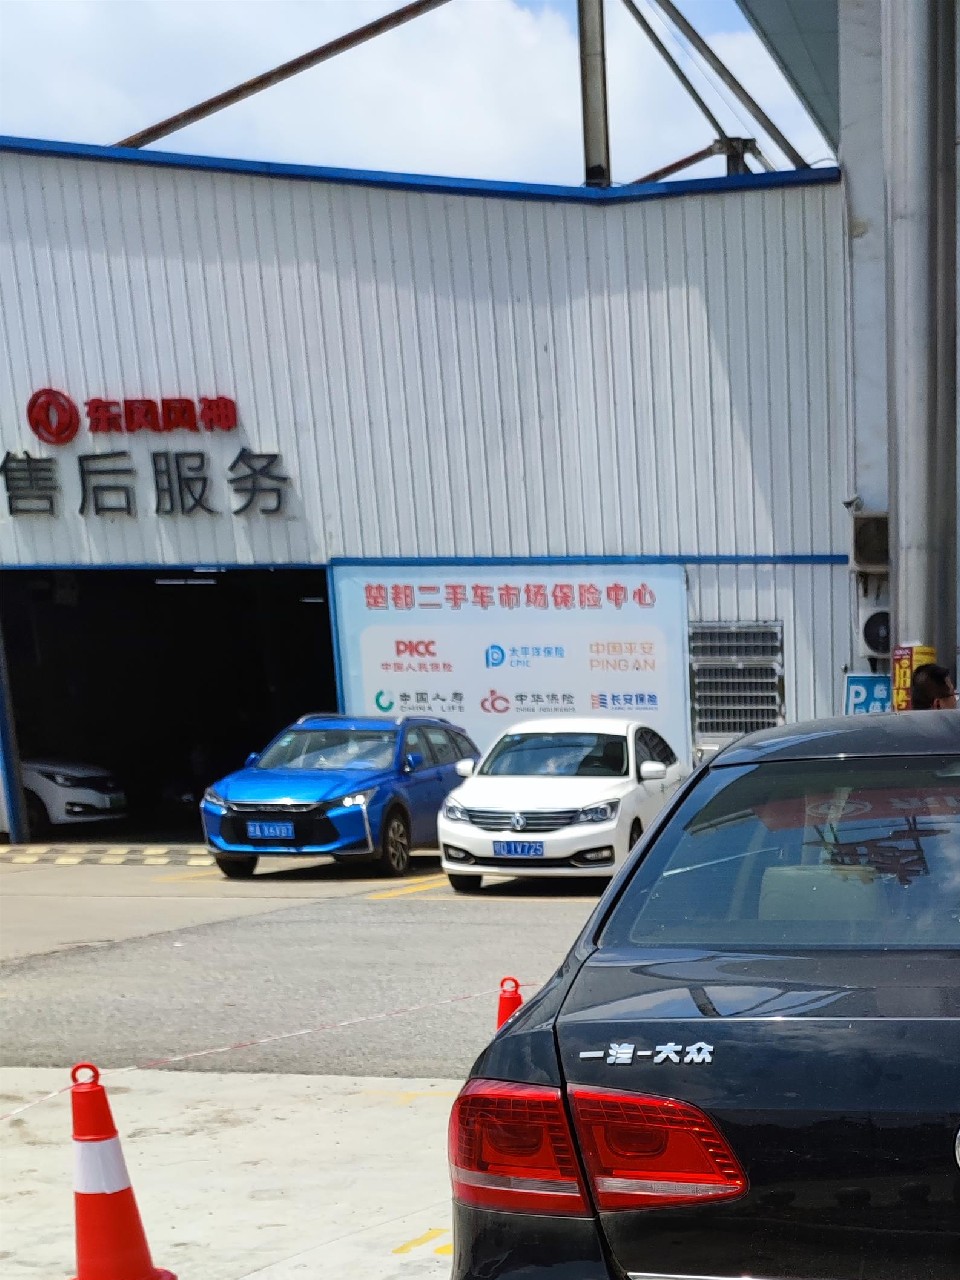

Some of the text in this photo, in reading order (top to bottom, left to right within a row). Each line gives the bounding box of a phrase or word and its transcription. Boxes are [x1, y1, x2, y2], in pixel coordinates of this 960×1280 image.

[85, 396, 238, 433] 东风风神
[0, 448, 290, 516] 售后服务
[364, 582, 657, 610] 楚都二手车市场保险中心
[395, 640, 437, 658] PICC
[589, 642, 655, 655] 中国平安
[590, 659, 656, 671] PING AN
[400, 692, 464, 704] 中国人寿
[611, 693, 658, 706] 长安保险
[579, 1041, 714, 1066] 一汽-大众
